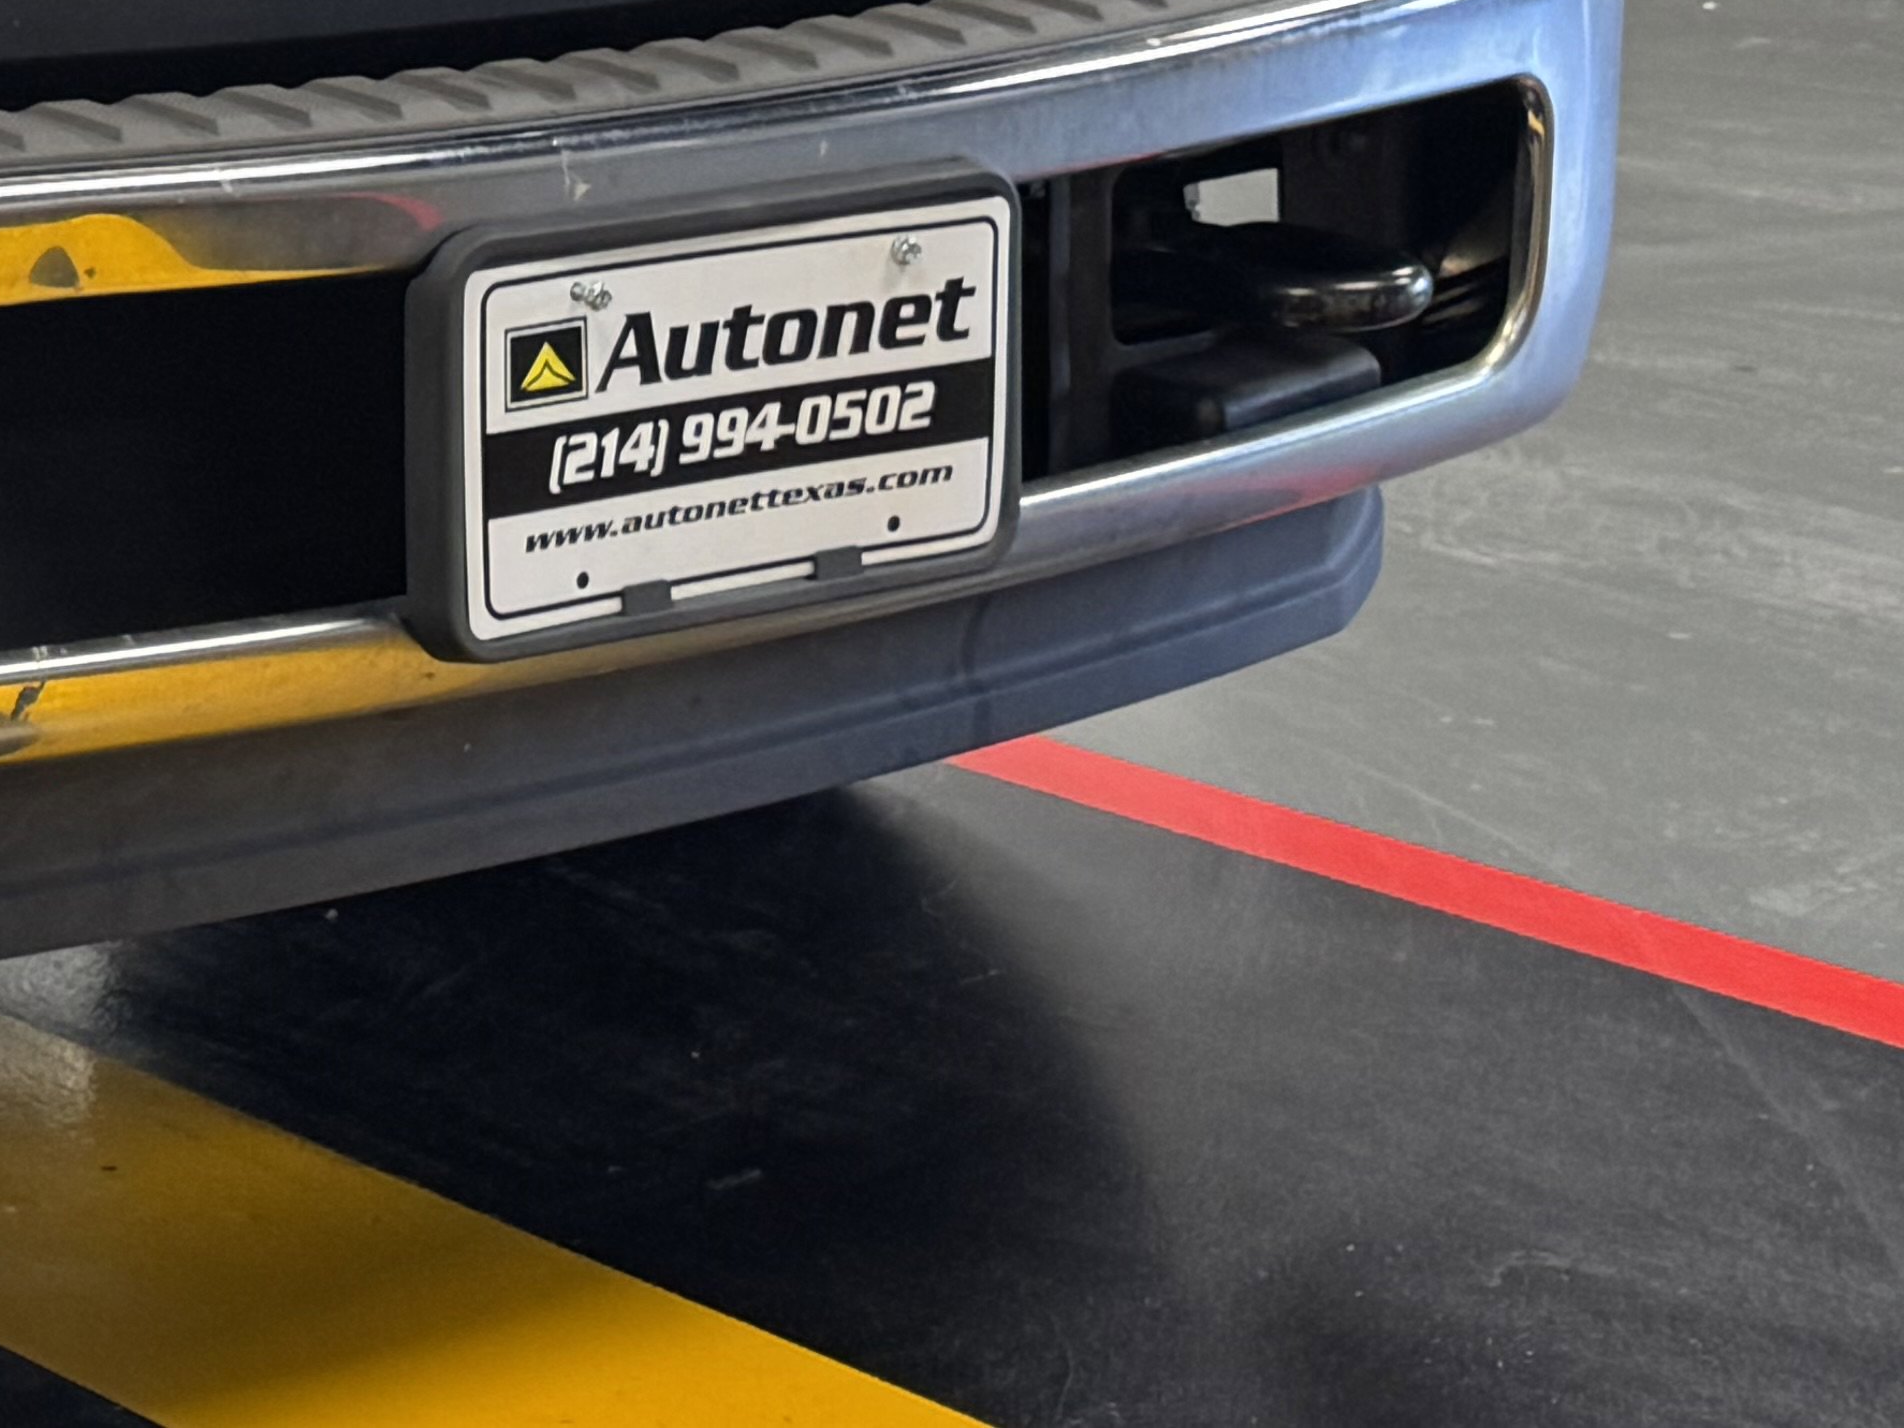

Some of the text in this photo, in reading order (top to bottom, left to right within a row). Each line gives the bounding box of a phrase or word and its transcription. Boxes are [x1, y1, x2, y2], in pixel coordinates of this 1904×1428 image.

[594, 276, 976, 393] Autonet
[548, 380, 937, 495] (214) 994-0502
[524, 464, 954, 554] www.autonettexas.com
